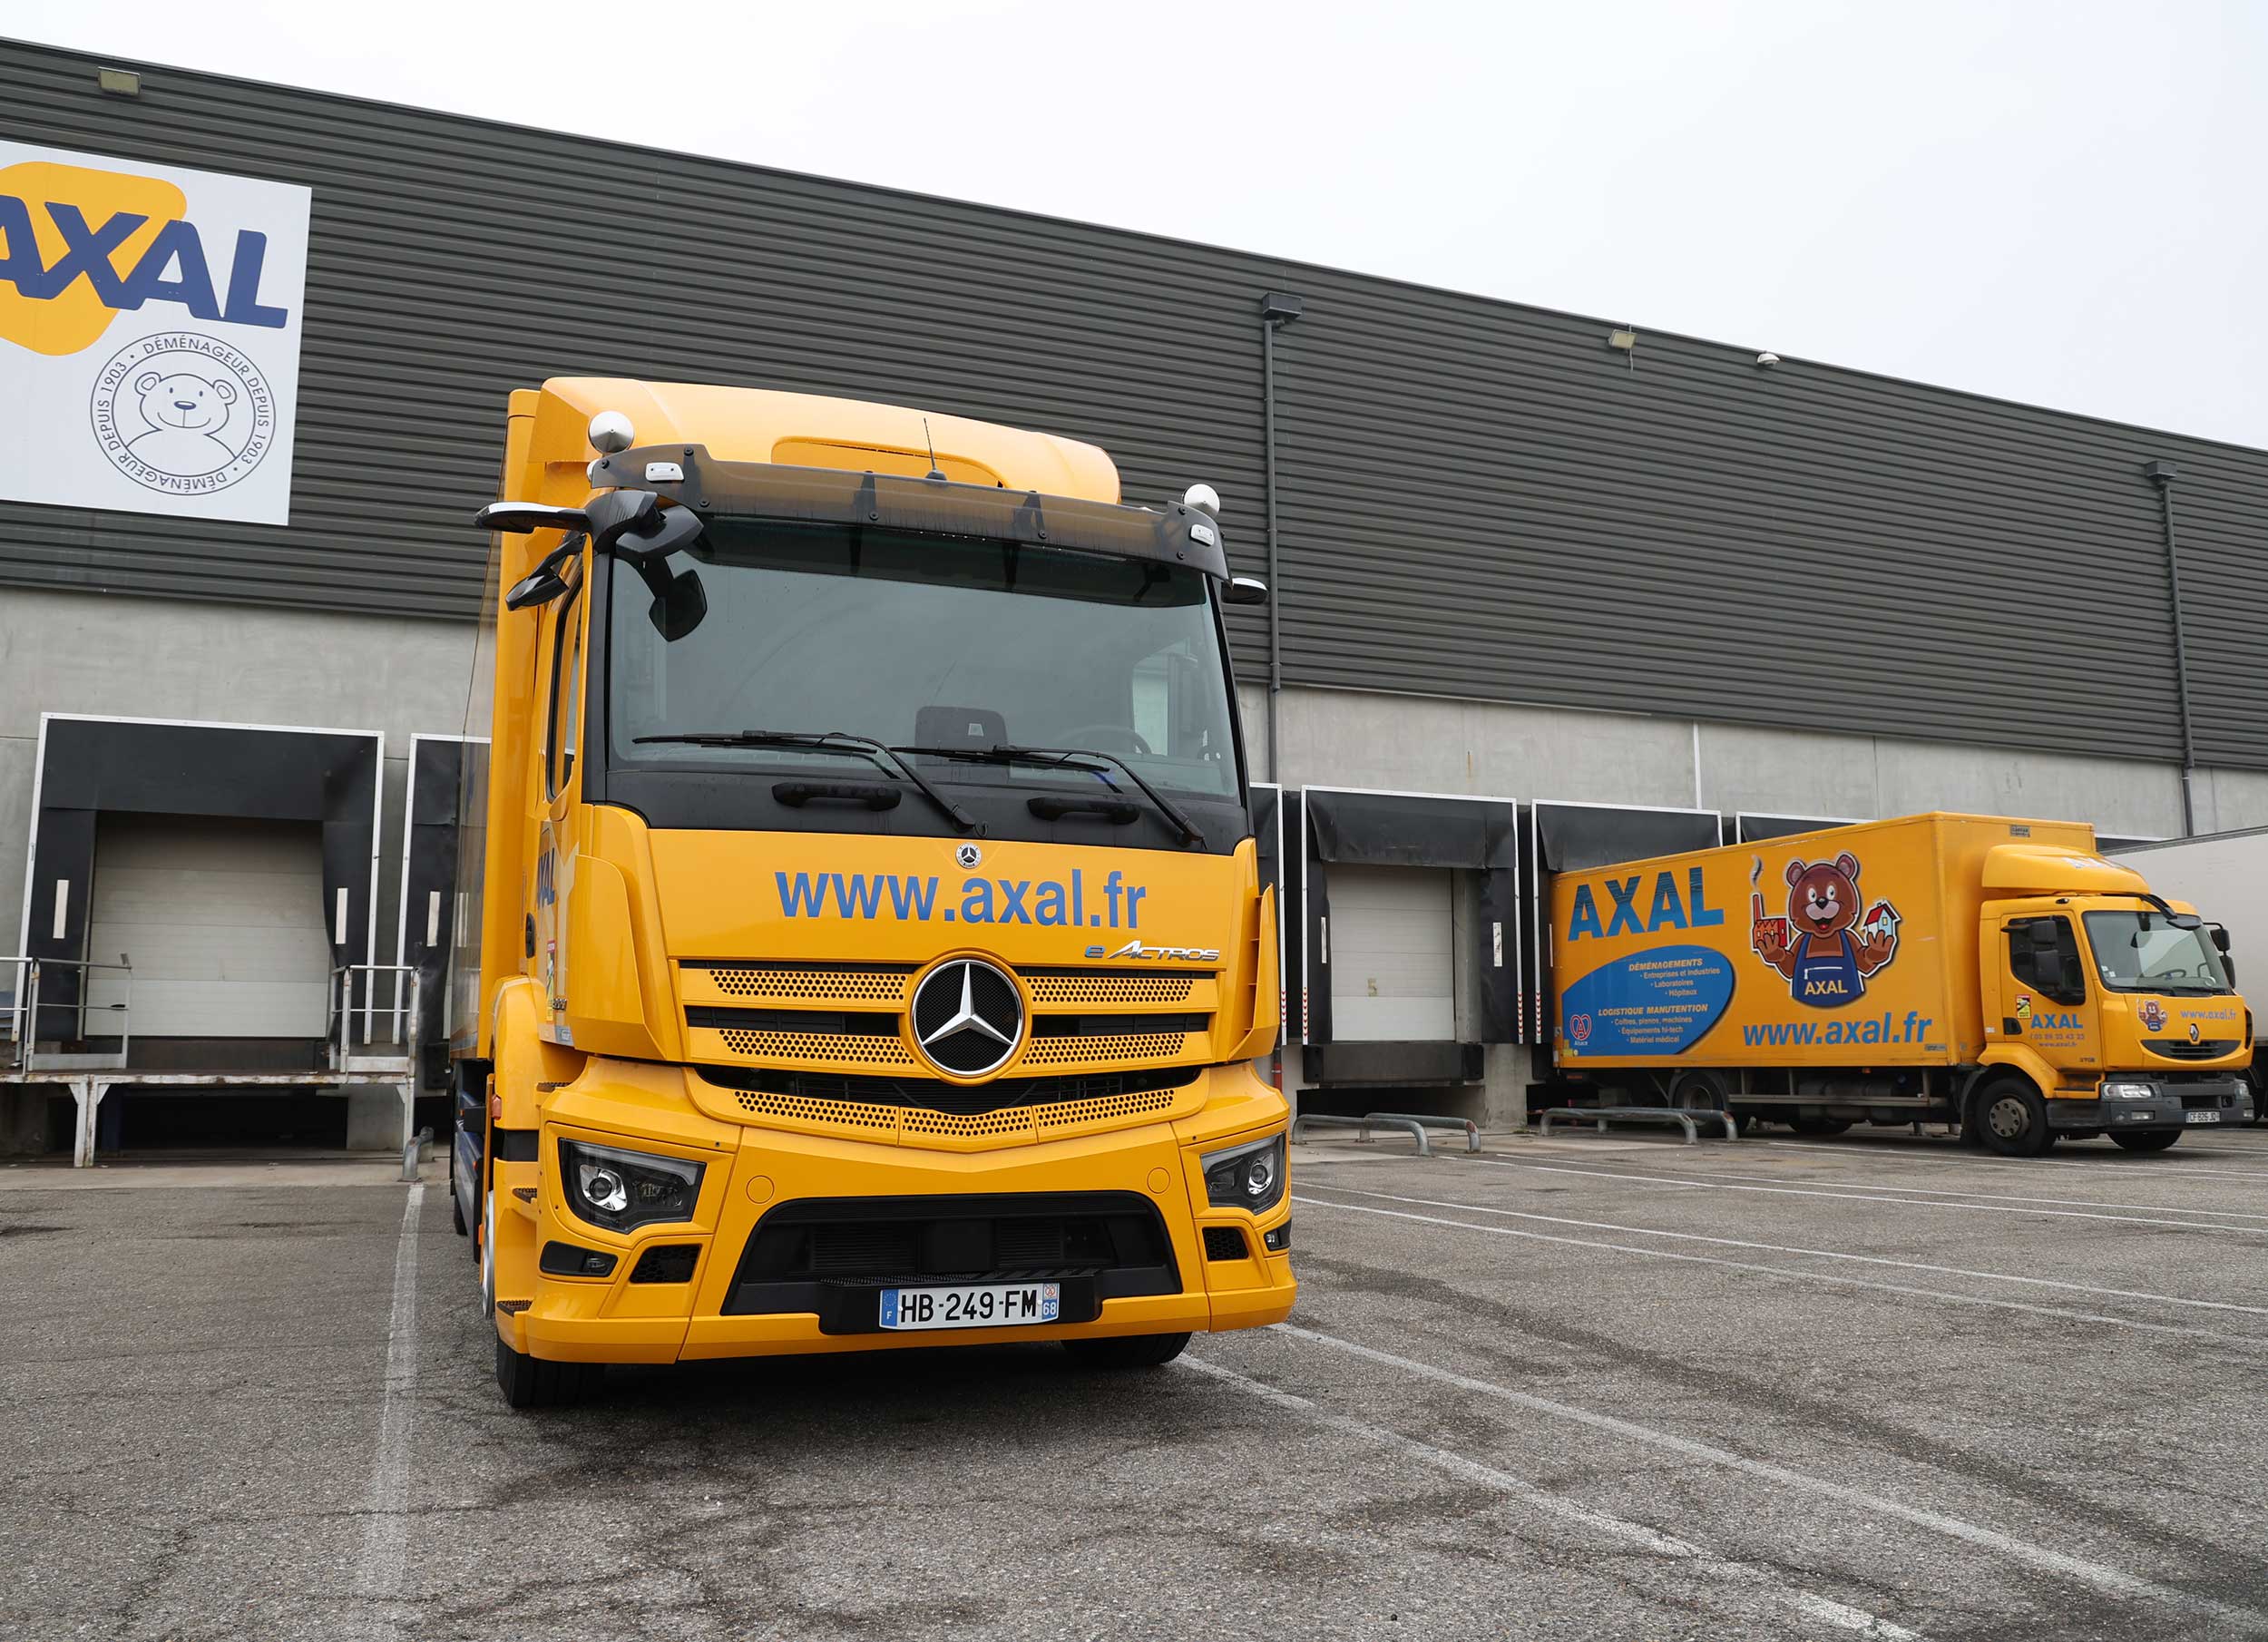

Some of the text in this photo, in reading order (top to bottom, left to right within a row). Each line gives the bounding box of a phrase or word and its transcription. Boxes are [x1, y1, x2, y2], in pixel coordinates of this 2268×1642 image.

[142, 334, 269, 464] DÉMÉNAGEUR DEPUIS 1903
[97, 361, 228, 494] DÉMÉNAGEUR DEPUIS 1903
[774, 867, 1147, 930] www.axal.fr
[1568, 865, 1725, 943] AXAL
[1804, 979, 1848, 996] AXAL
[1598, 1003, 1709, 1017] LOGISTIQUE MANUTENTION
[2030, 1013, 2084, 1029] AXAL
[2179, 1008, 2237, 1021] www.axal.fr
[1742, 1010, 1934, 1047] www.axal.fr
[886, 1289, 1057, 1323] F HB-249-FM 68
